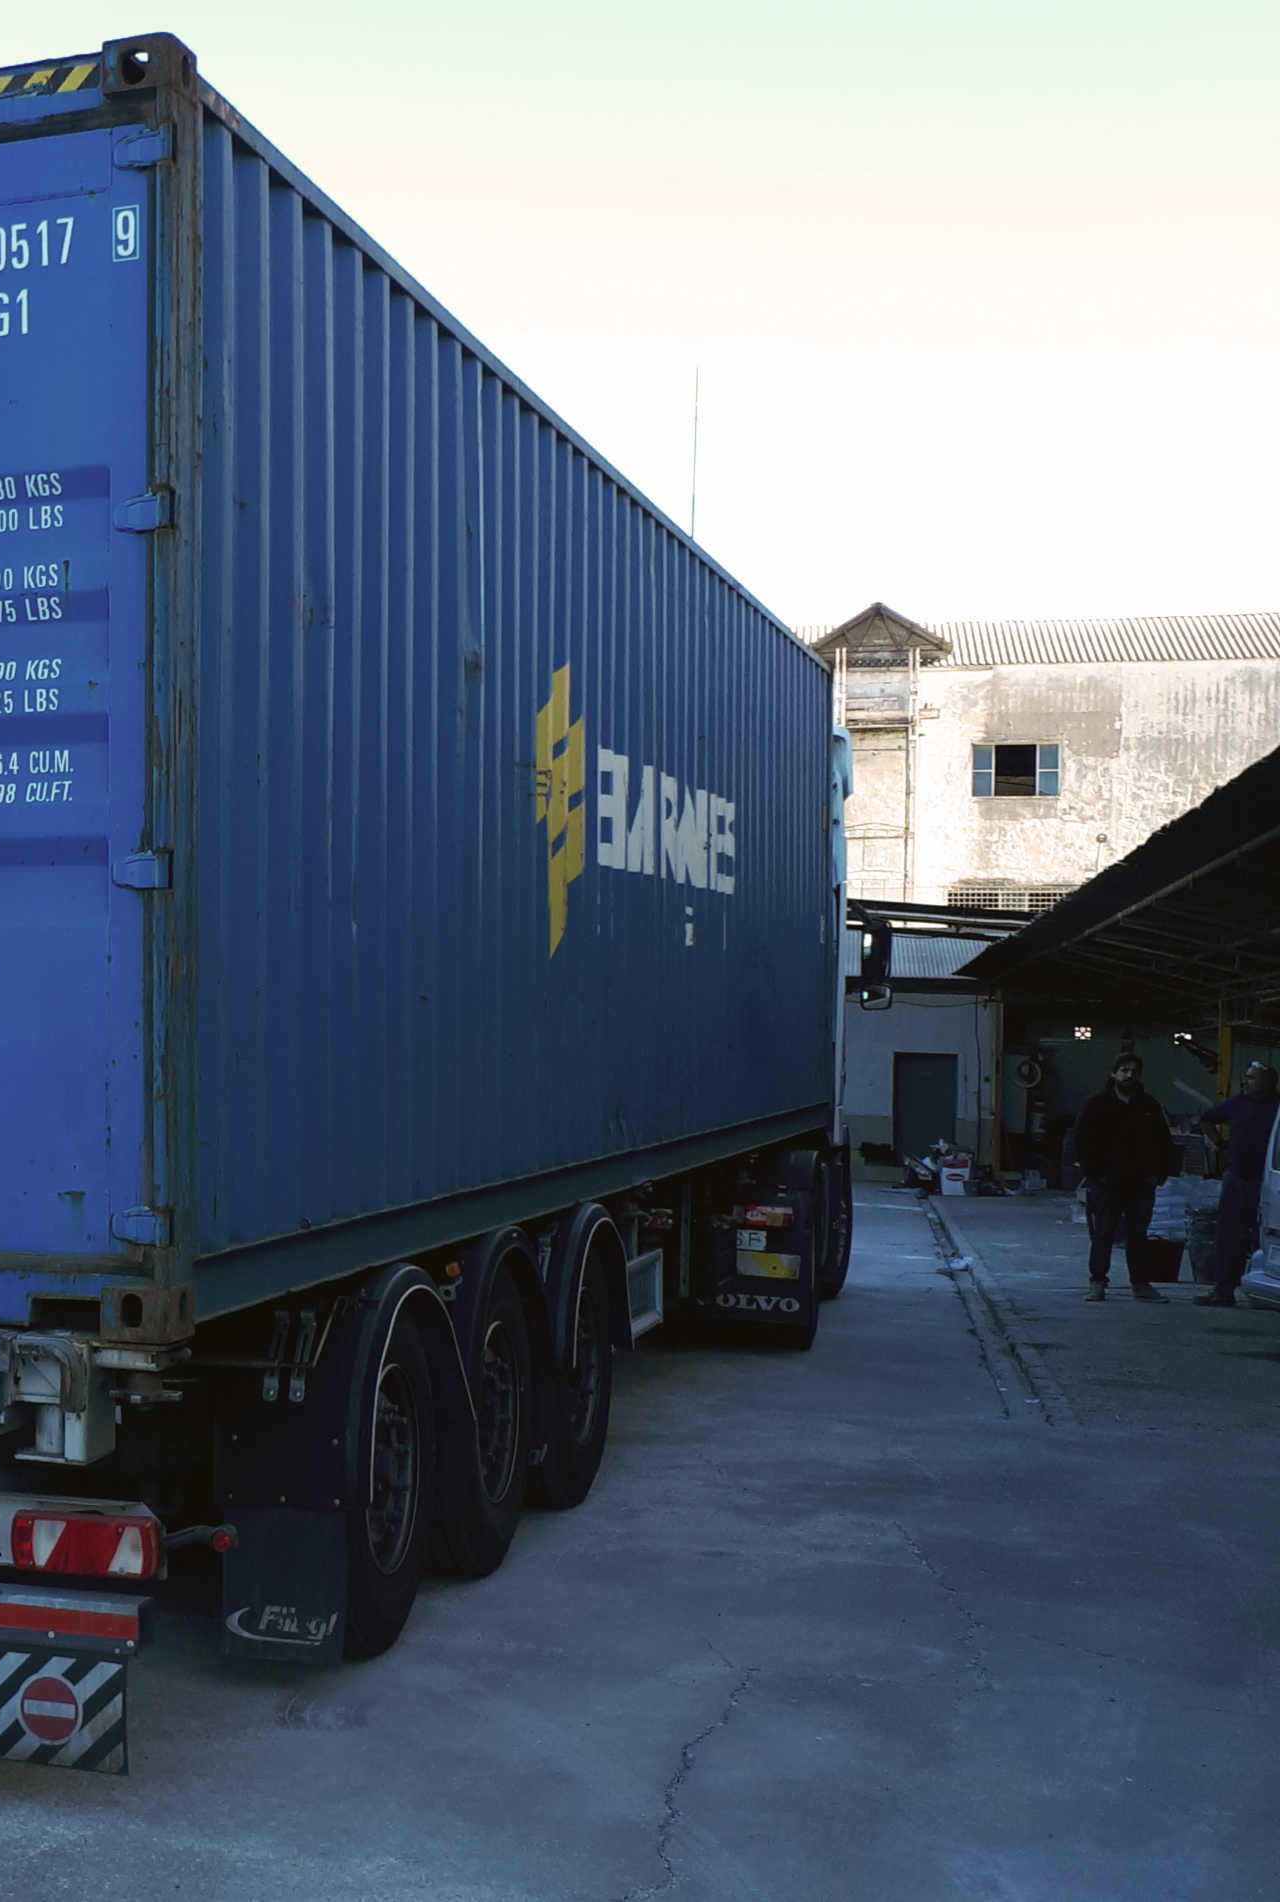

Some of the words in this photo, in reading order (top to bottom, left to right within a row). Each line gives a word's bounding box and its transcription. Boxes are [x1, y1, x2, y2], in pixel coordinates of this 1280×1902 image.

[116, 210, 136, 256] 9
[25, 473, 62, 498] KGS
[29, 505, 63, 530] LBS
[24, 564, 58, 589] KGS
[25, 597, 62, 622] LBS
[25, 659, 62, 681] KGS
[24, 689, 58, 713] LBS
[696, 1293, 800, 1313] OLVO
[258, 1604, 339, 1640] Fligl
